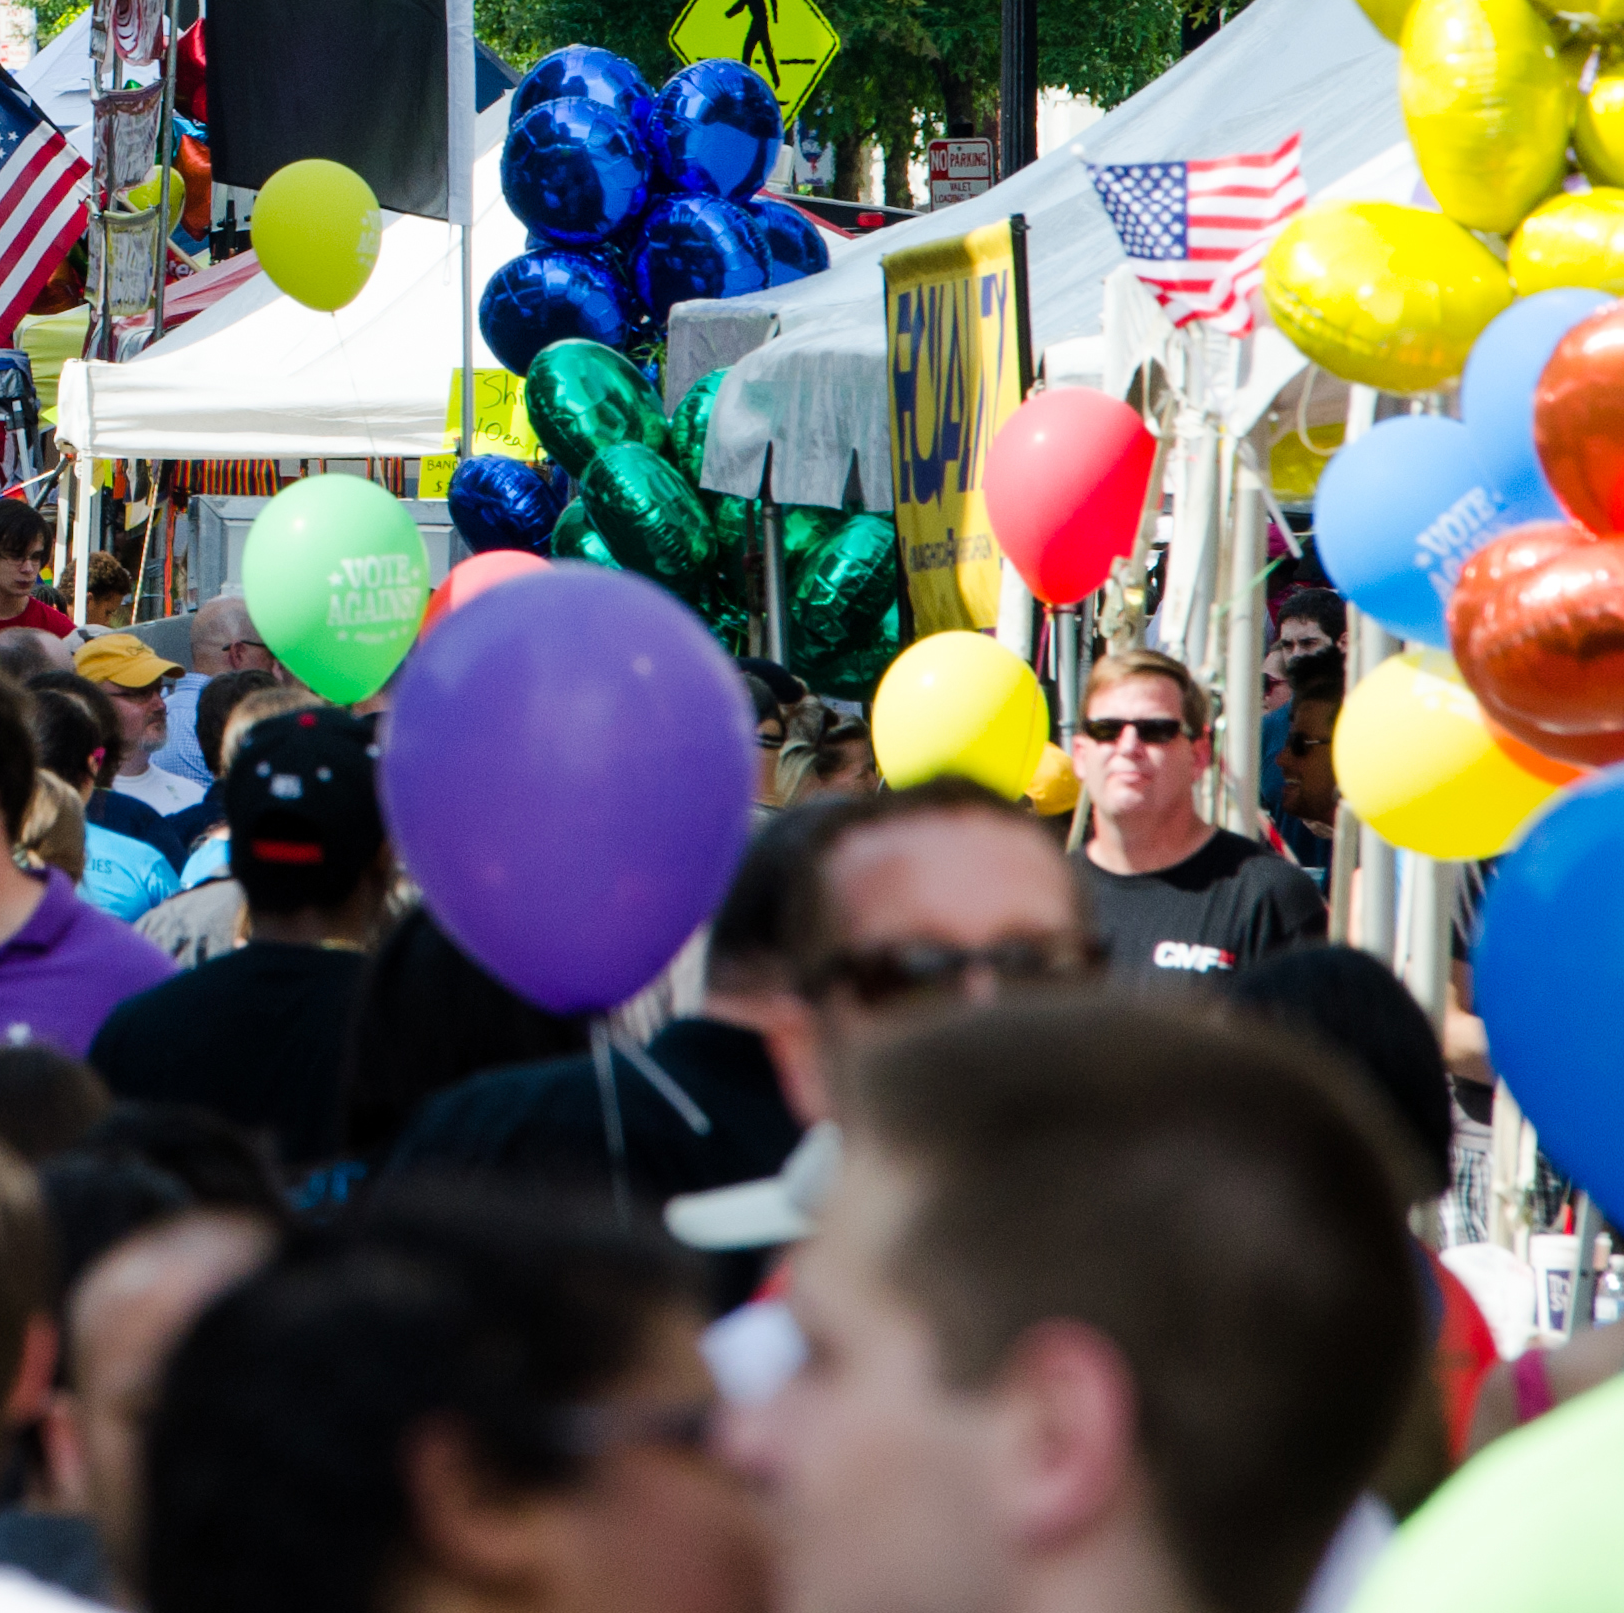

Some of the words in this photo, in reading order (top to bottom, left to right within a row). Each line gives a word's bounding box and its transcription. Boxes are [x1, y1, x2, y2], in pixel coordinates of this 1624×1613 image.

[930, 149, 948, 172] NO
[950, 152, 987, 168] PARKING
[949, 181, 971, 192] VALET
[1417, 487, 1494, 556] VOTE
[340, 553, 410, 589] VOTE
[327, 586, 421, 626] AGAINST
